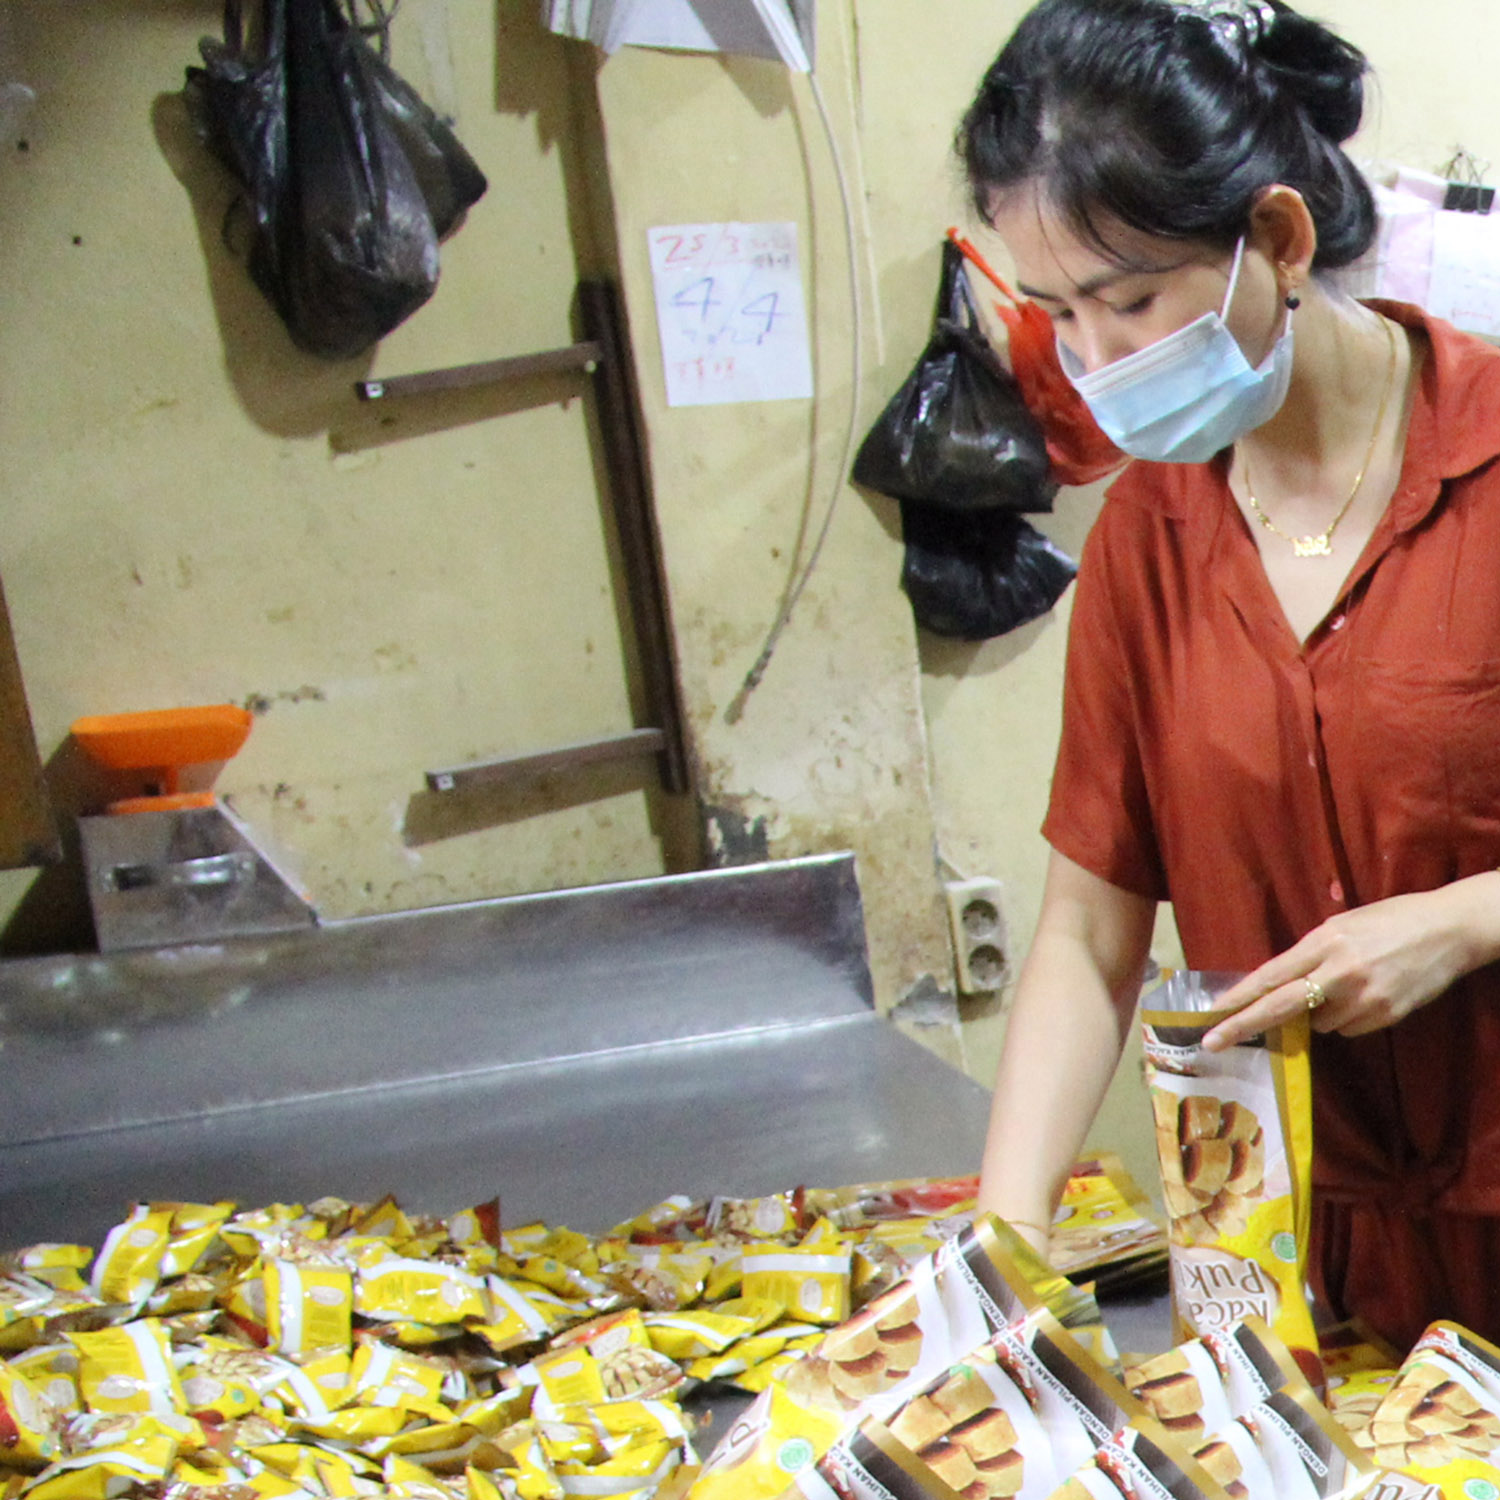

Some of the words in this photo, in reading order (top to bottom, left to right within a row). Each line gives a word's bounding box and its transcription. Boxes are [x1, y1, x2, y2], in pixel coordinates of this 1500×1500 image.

[1177, 1260, 1265, 1299] Puk
[1186, 1299, 1268, 1326] Kaca
[1036, 1365, 1073, 1405] PILIHAN
[1072, 1401, 1110, 1440] DENGAN
